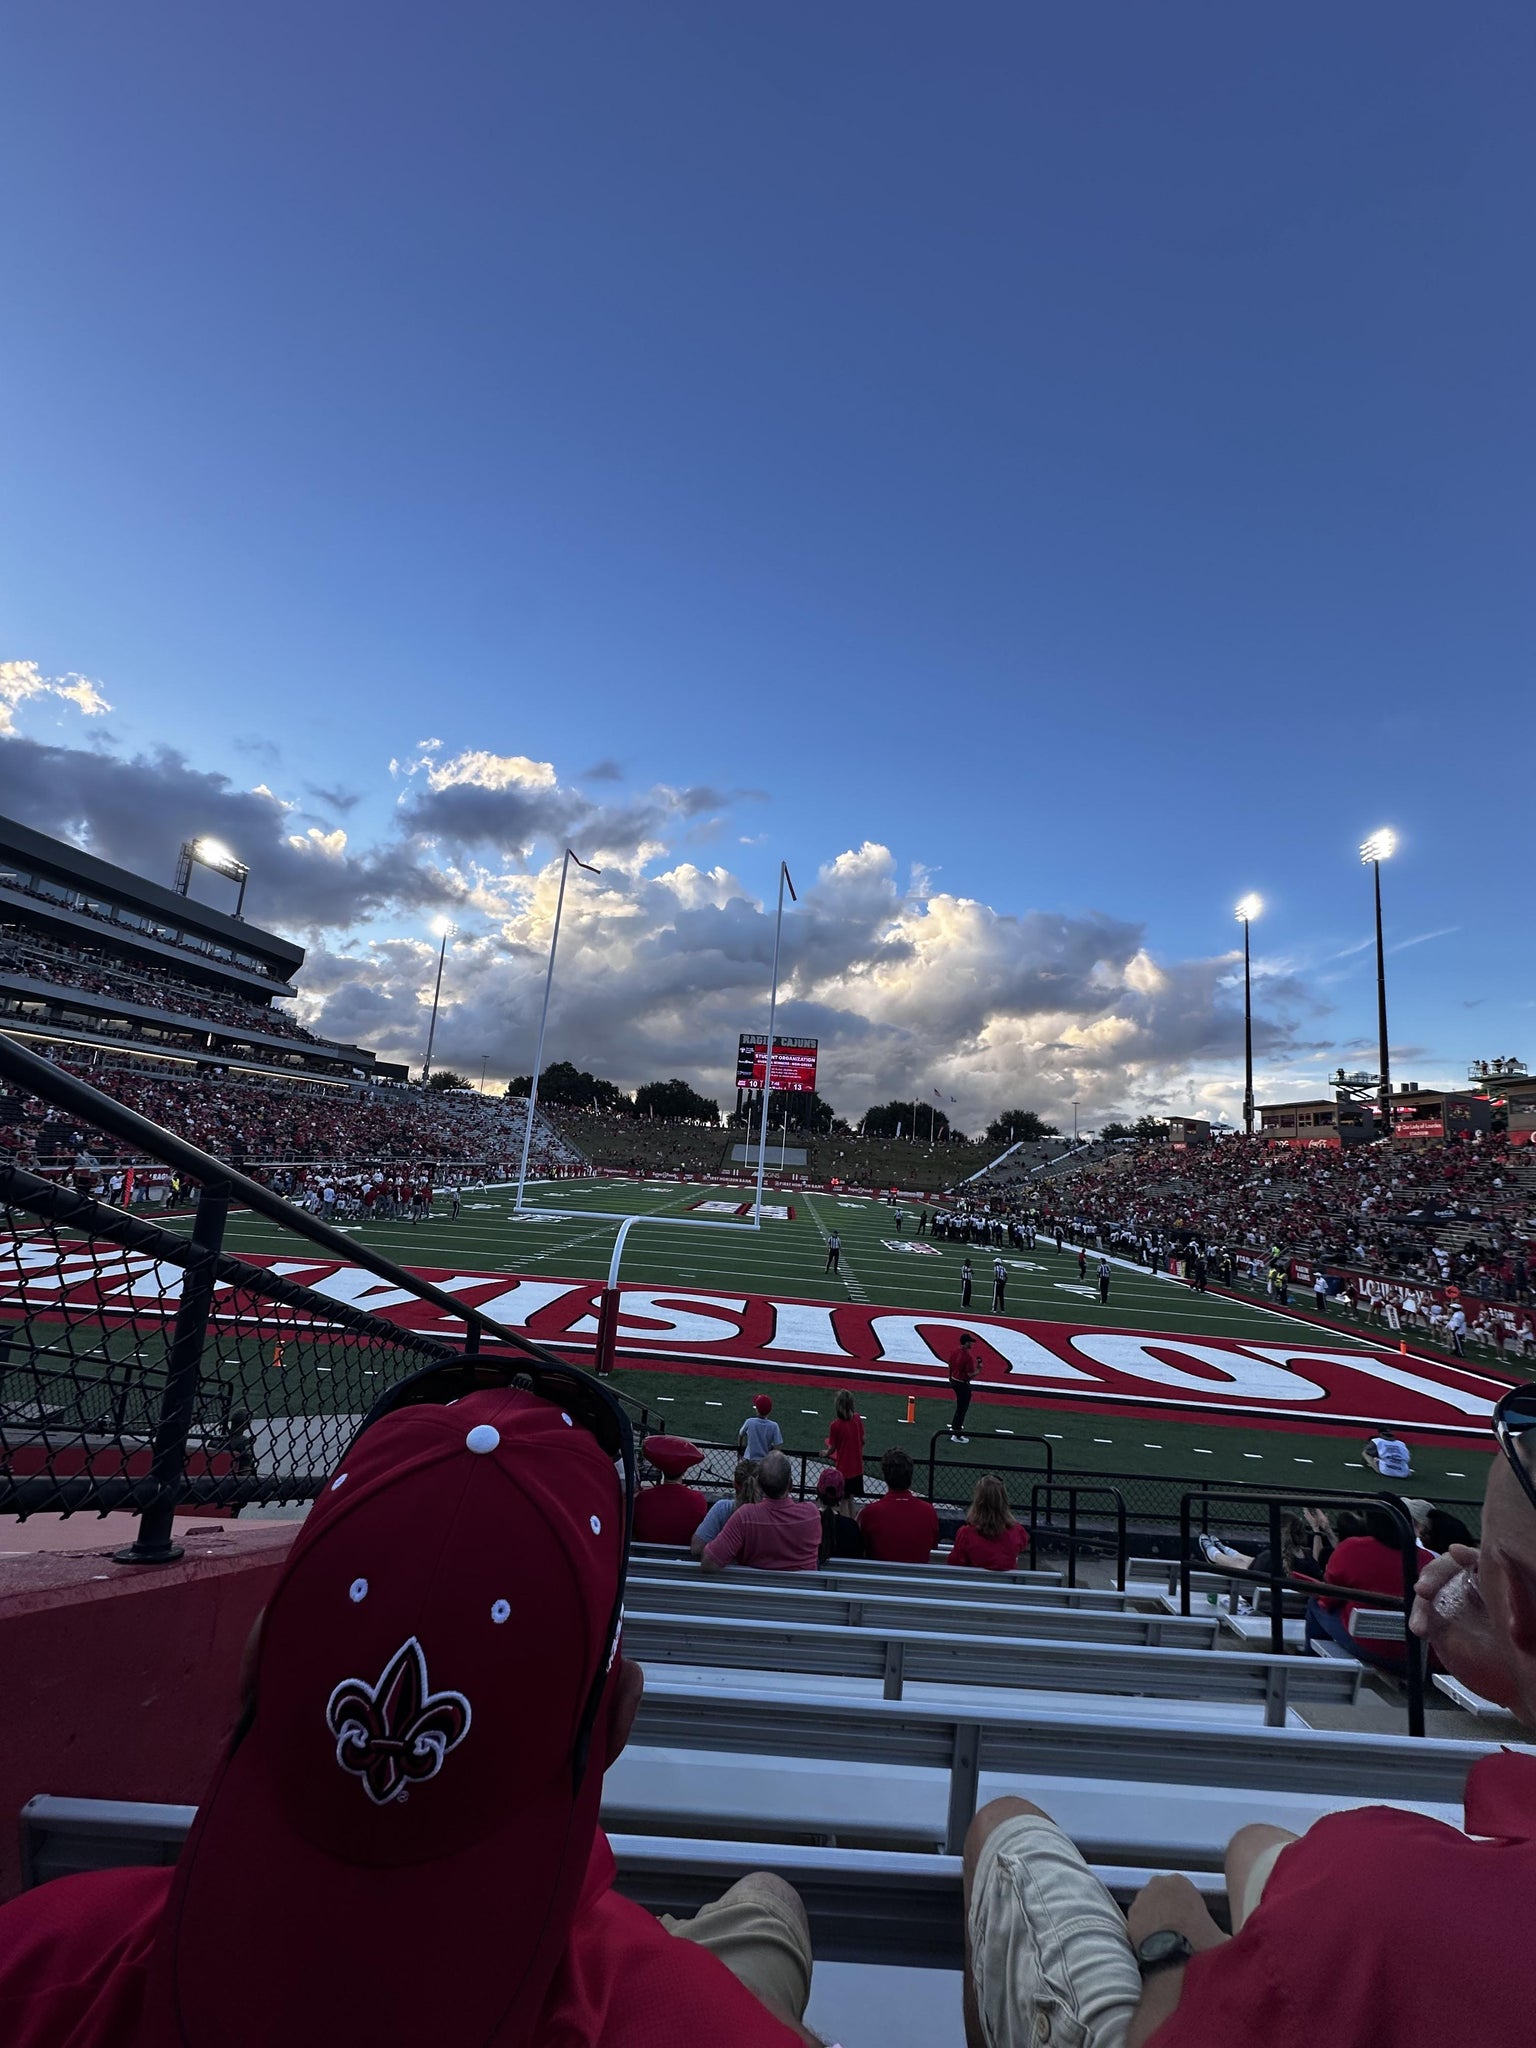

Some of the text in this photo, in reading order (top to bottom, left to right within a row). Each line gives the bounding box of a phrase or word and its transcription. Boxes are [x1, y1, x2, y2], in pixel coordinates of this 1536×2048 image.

[781, 1037, 817, 1049] CAJUNS
[749, 1080, 758, 1088] 10
[793, 1083, 802, 1091] 13
